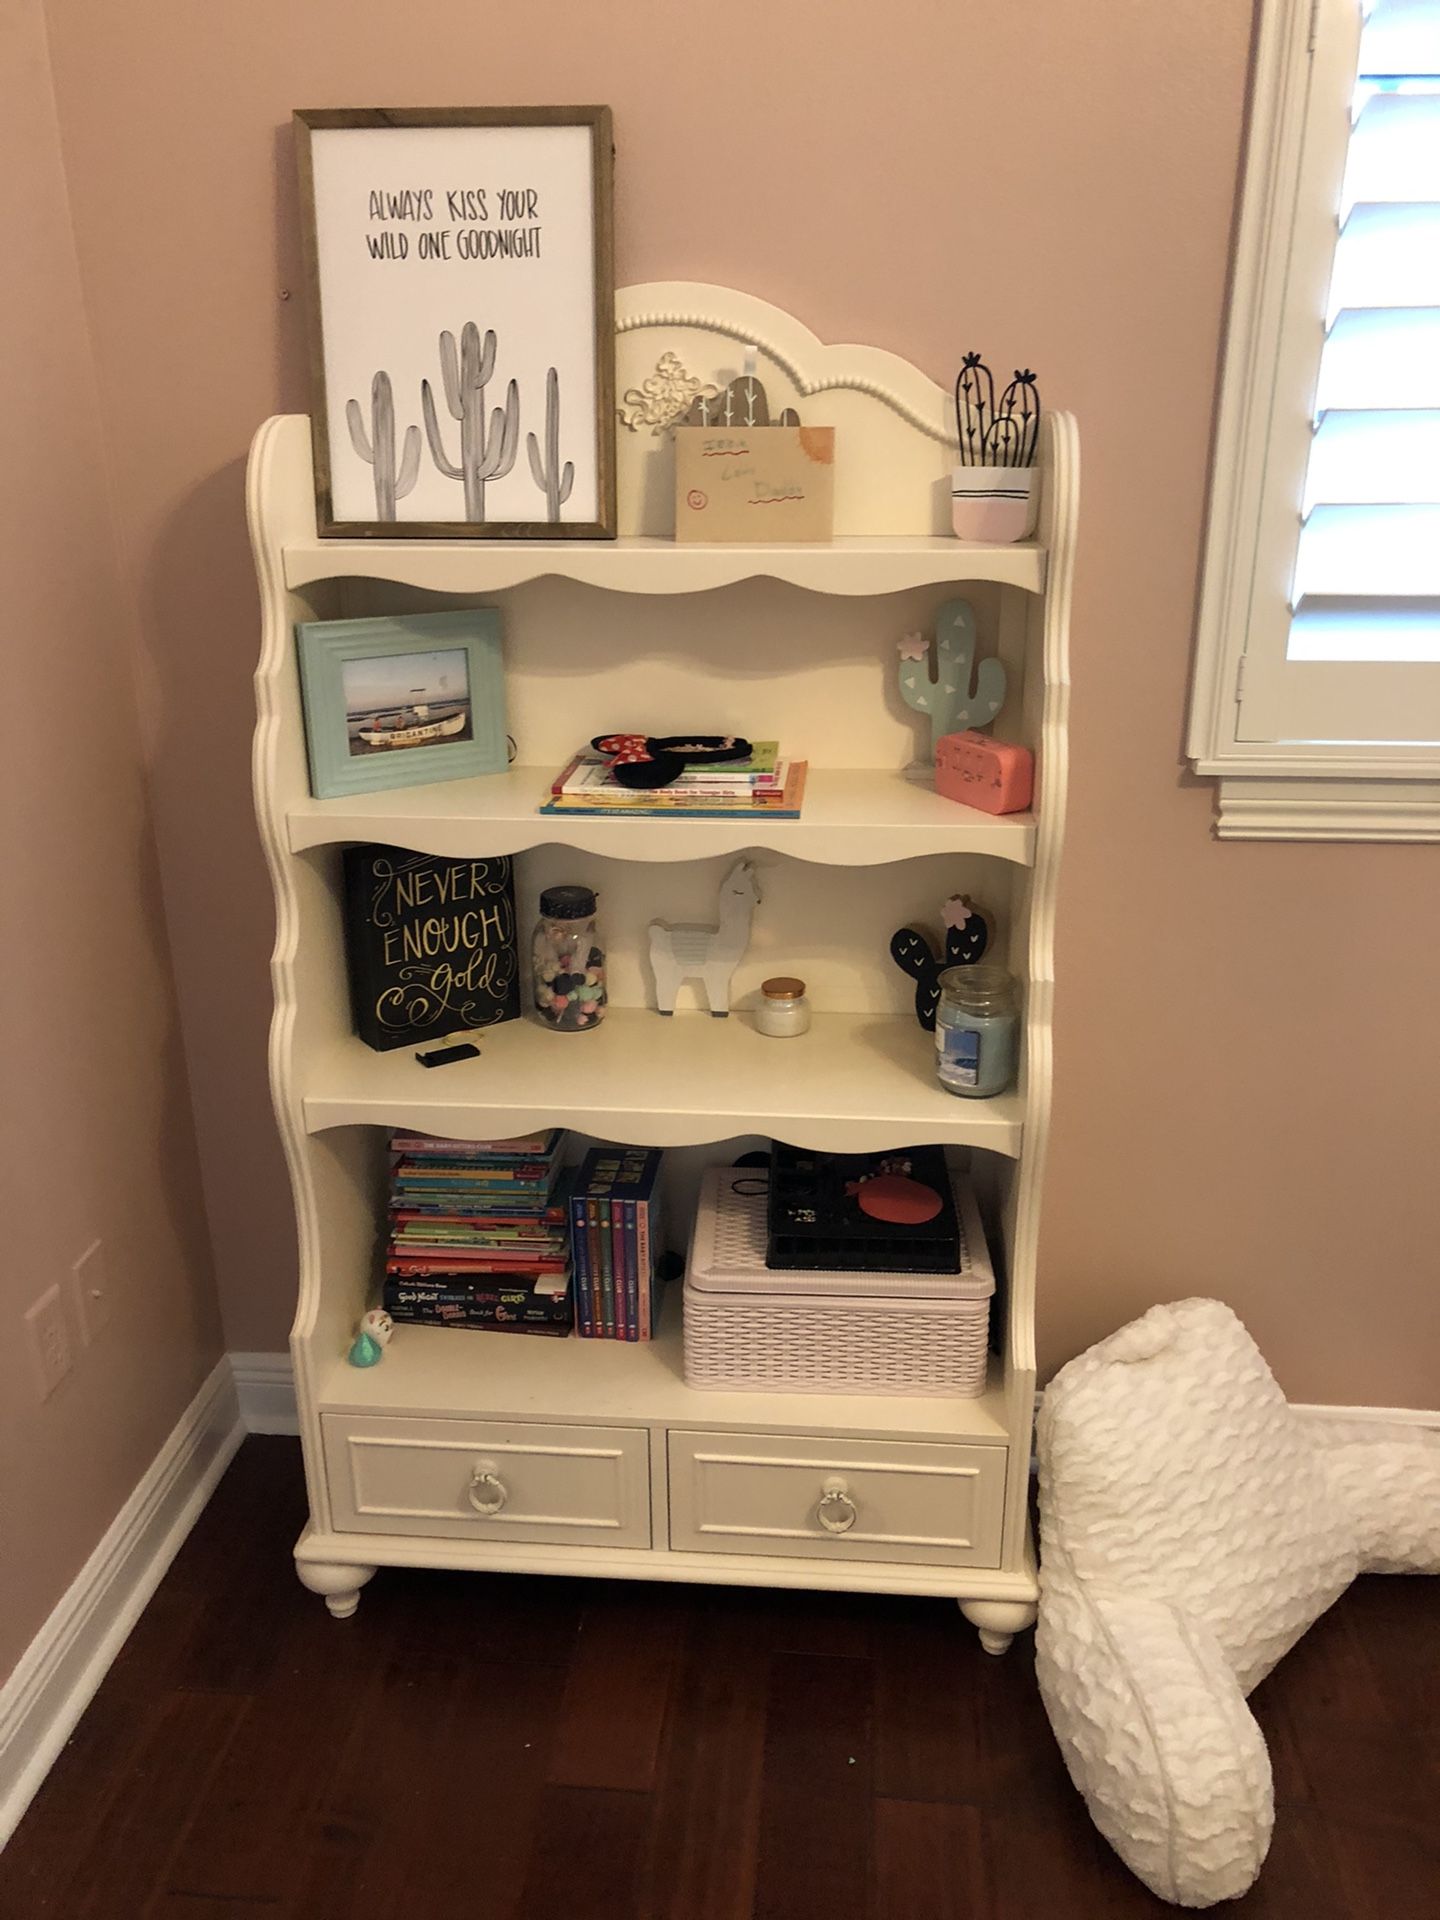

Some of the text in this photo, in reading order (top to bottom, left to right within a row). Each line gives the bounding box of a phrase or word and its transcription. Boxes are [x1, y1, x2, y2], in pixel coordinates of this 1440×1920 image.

[369, 188, 539, 222] ALWAYS KISS YOUR
[366, 226, 543, 261] WILD ONE GOODNIGHT
[390, 725, 442, 740] BRIGANTINE
[396, 862, 489, 915] NEVER
[383, 906, 505, 966] ENOUGH
[627, 1280, 635, 1294] CLUB
